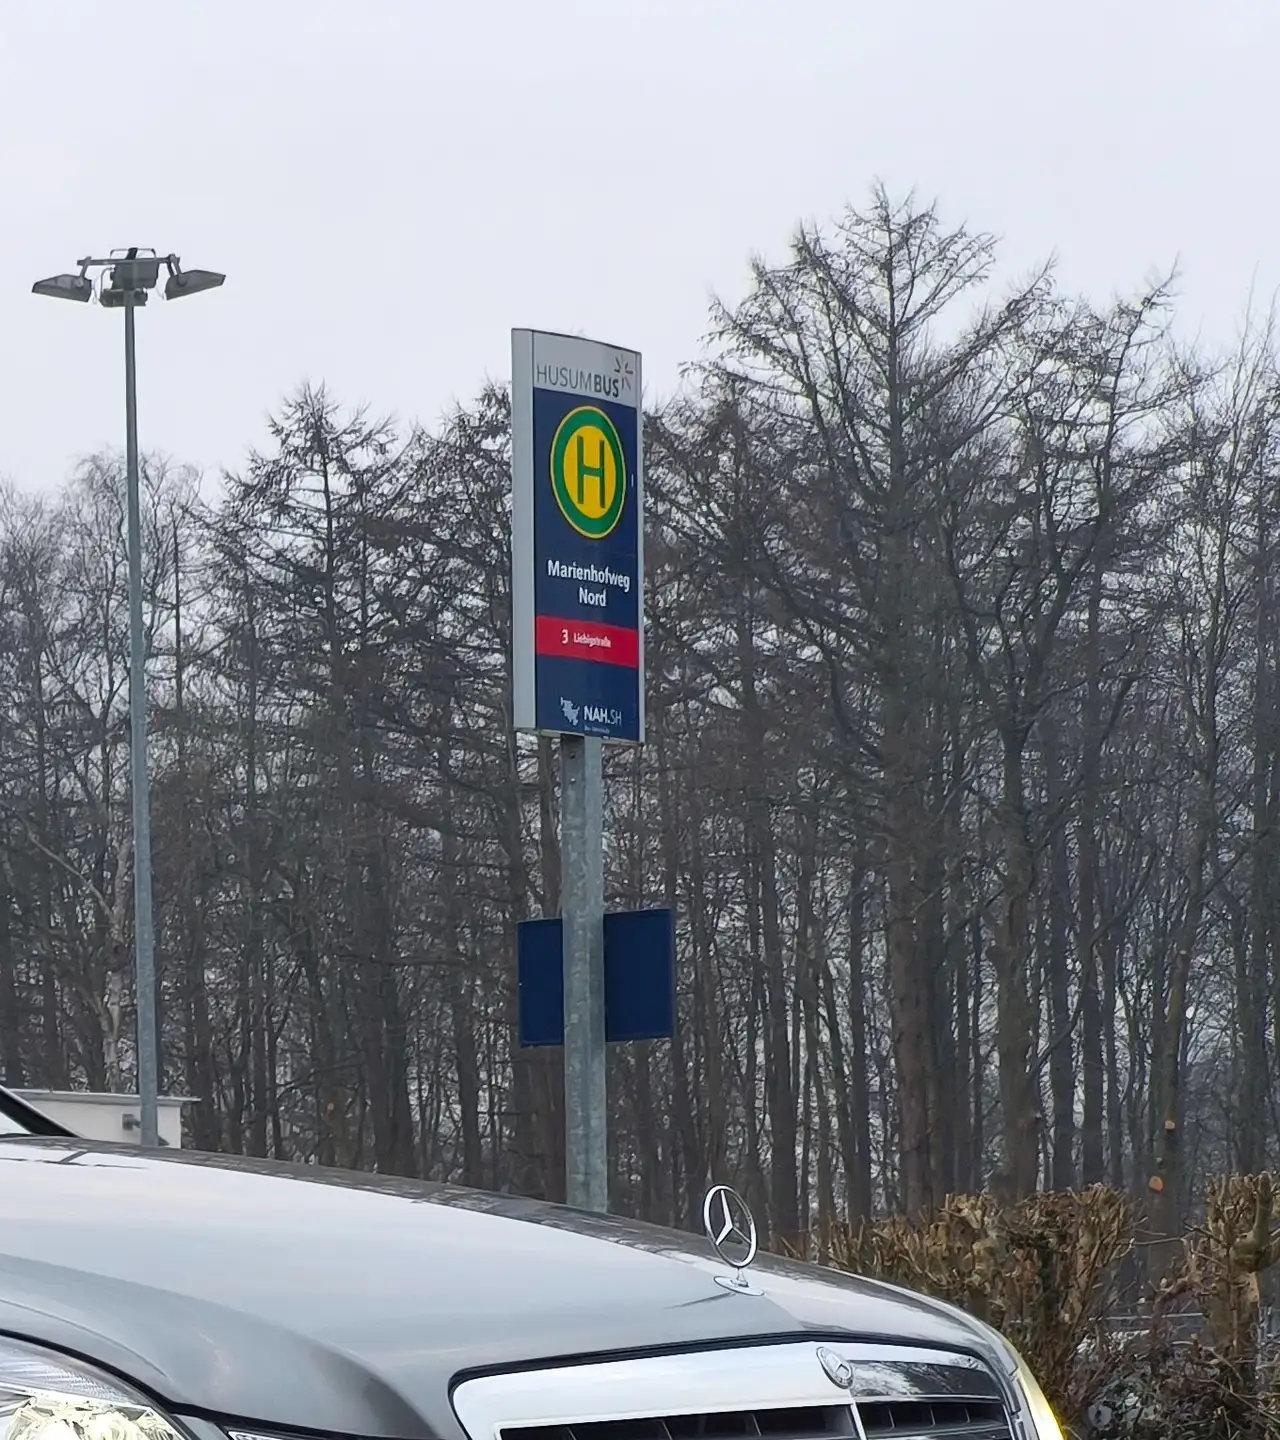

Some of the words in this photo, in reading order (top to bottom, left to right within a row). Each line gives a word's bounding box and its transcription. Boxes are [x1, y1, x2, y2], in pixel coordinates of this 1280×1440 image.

[577, 434, 606, 509] H
[547, 559, 630, 593] Marienhofweg
[579, 587, 607, 607] Nord
[561, 628, 569, 645] 3
[583, 705, 622, 726] NAH.SH
